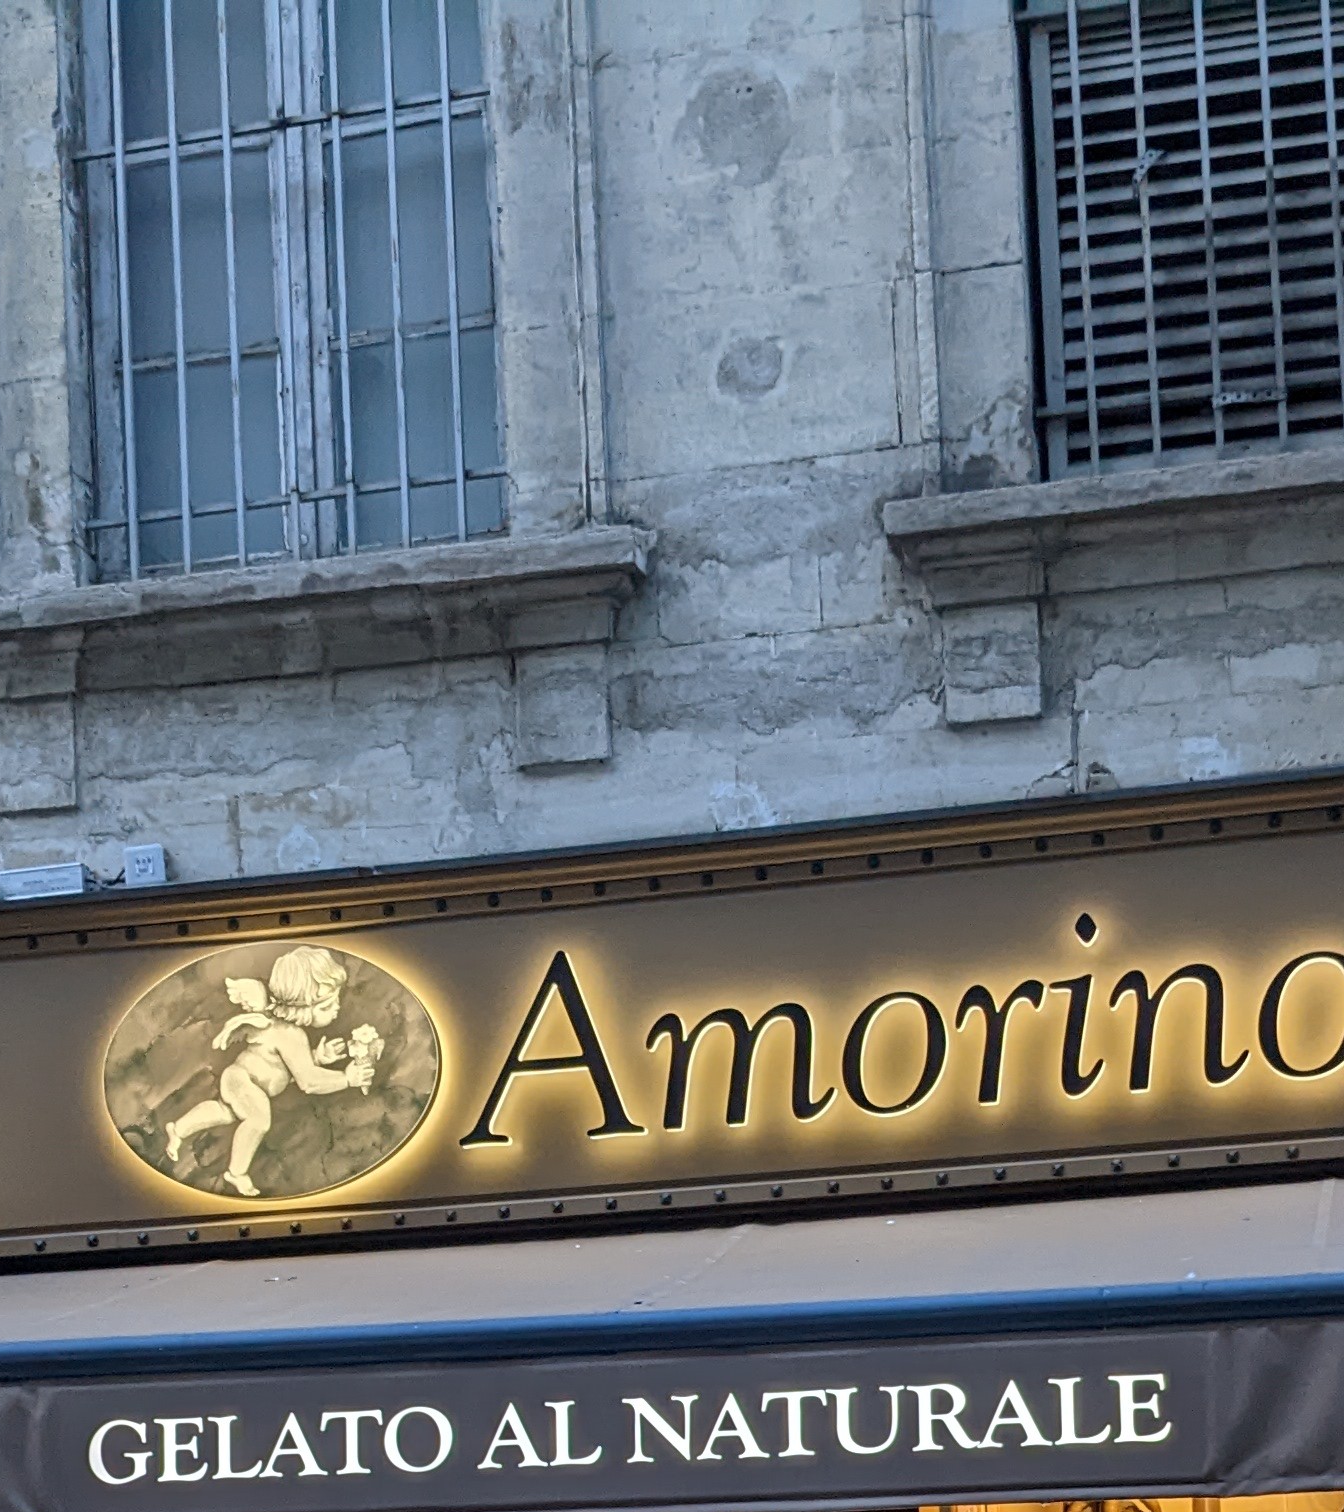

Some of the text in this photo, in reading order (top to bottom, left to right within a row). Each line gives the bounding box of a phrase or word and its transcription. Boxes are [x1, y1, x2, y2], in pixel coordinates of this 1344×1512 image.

[88, 1373, 1172, 1485] GELATO AL NATURALE
